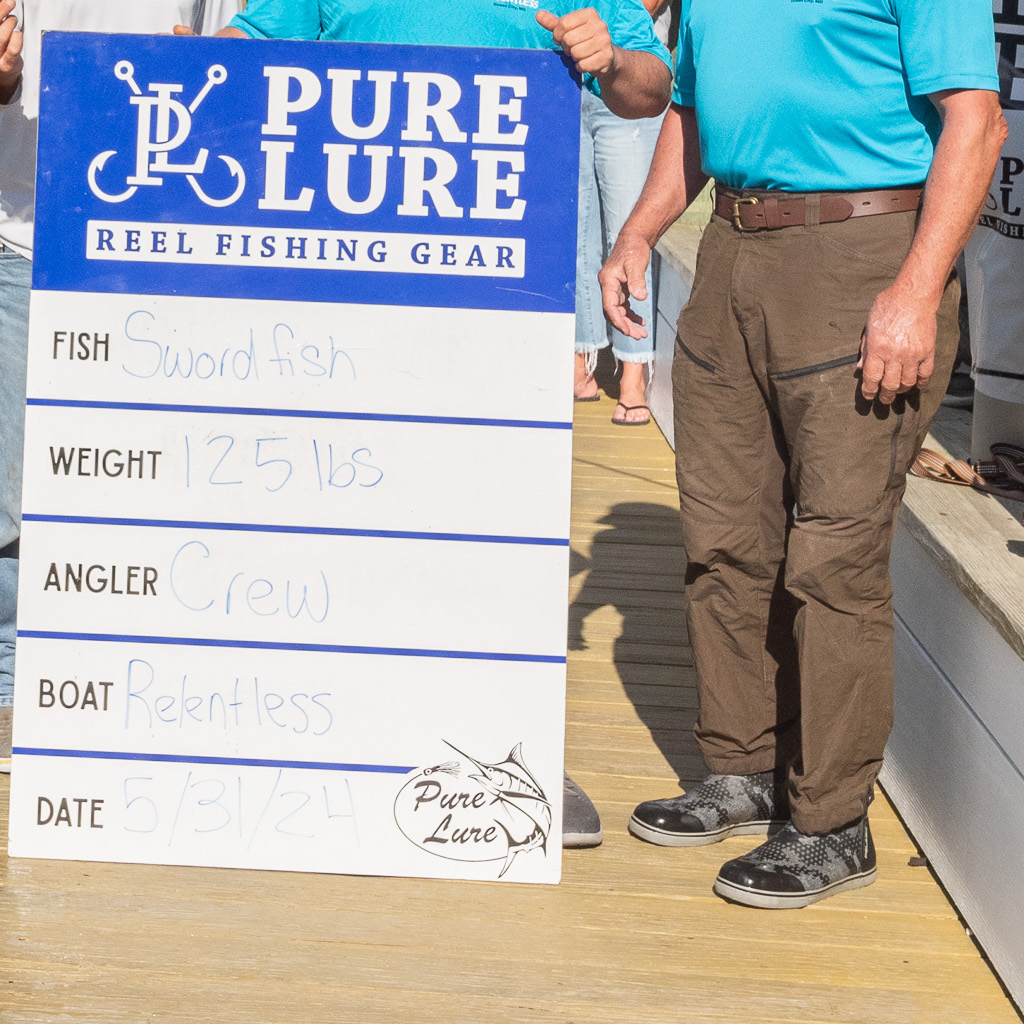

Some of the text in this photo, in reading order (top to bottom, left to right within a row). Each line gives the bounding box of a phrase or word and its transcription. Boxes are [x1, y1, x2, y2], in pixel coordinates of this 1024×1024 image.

[261, 65, 529, 146] PURE
[258, 140, 527, 221] LURE
[96, 228, 517, 268] REEL FISHING GEAR
[53, 330, 111, 362] FISH
[49, 447, 163, 480] WEIGHT
[185, 434, 384, 491] 125 lbs
[43, 562, 158, 596] ANGLER
[170, 540, 330, 622] Crew
[38, 679, 114, 711] BOAT
[124, 659, 333, 736] Relentless
[36, 797, 105, 828] DATE
[122, 769, 360, 850] 5/31/24
[413, 780, 486, 812] Pure
[424, 817, 498, 845] Lure
